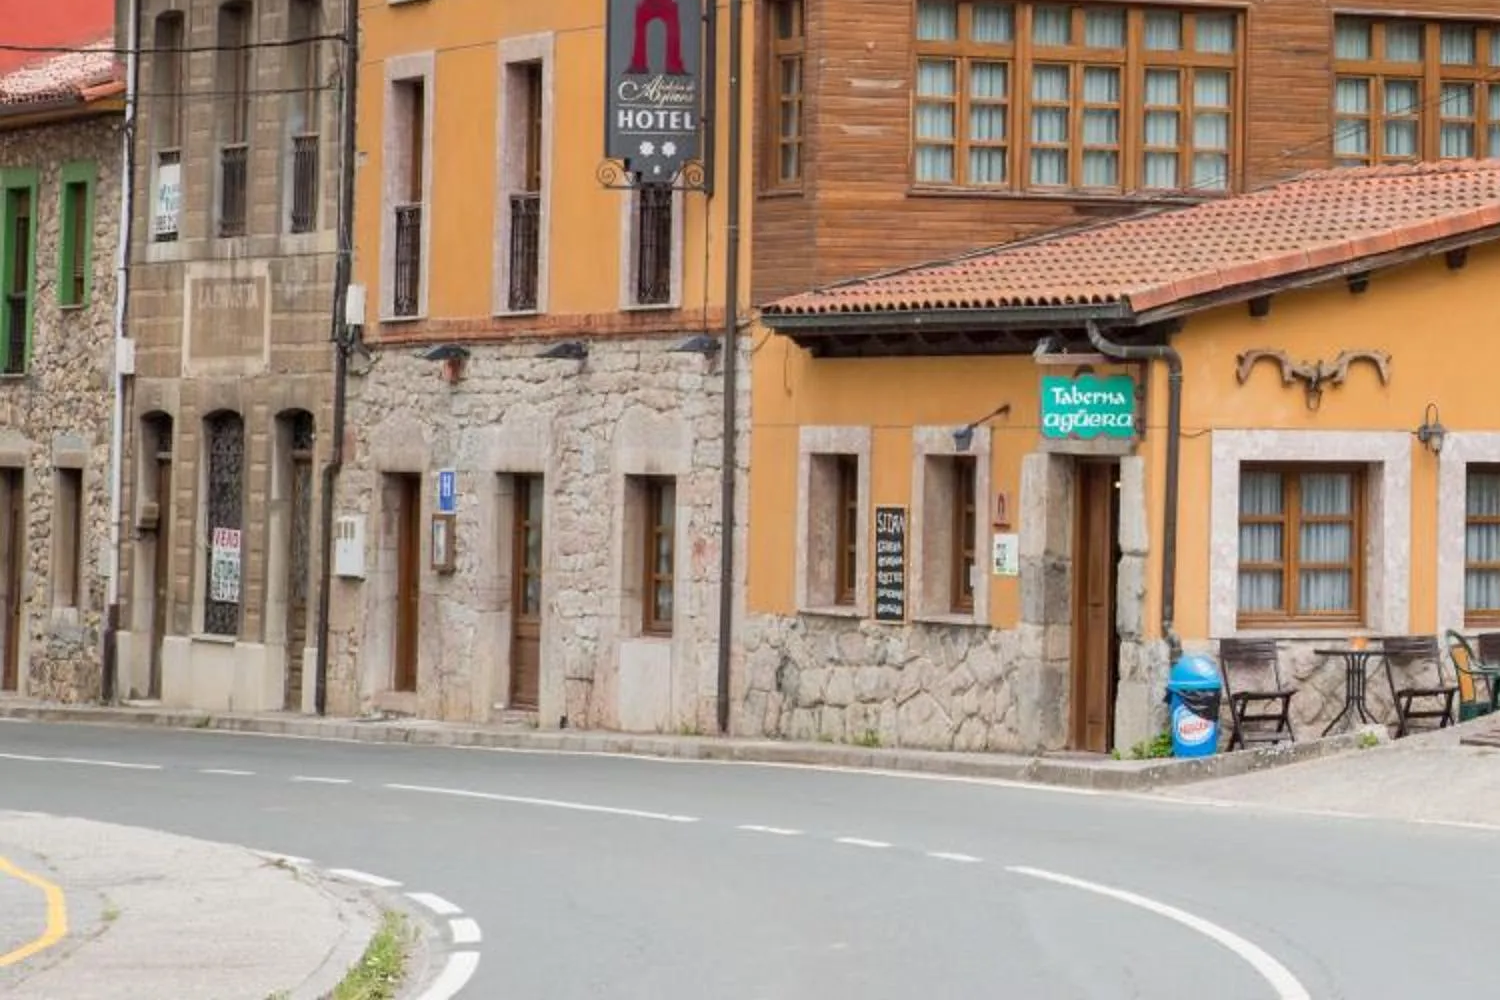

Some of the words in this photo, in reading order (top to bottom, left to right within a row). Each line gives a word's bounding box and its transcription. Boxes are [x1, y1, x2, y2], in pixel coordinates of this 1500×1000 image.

[618, 109, 696, 130] HOTEL
[1051, 385, 1126, 405] Taberna
[443, 475, 451, 497] H
